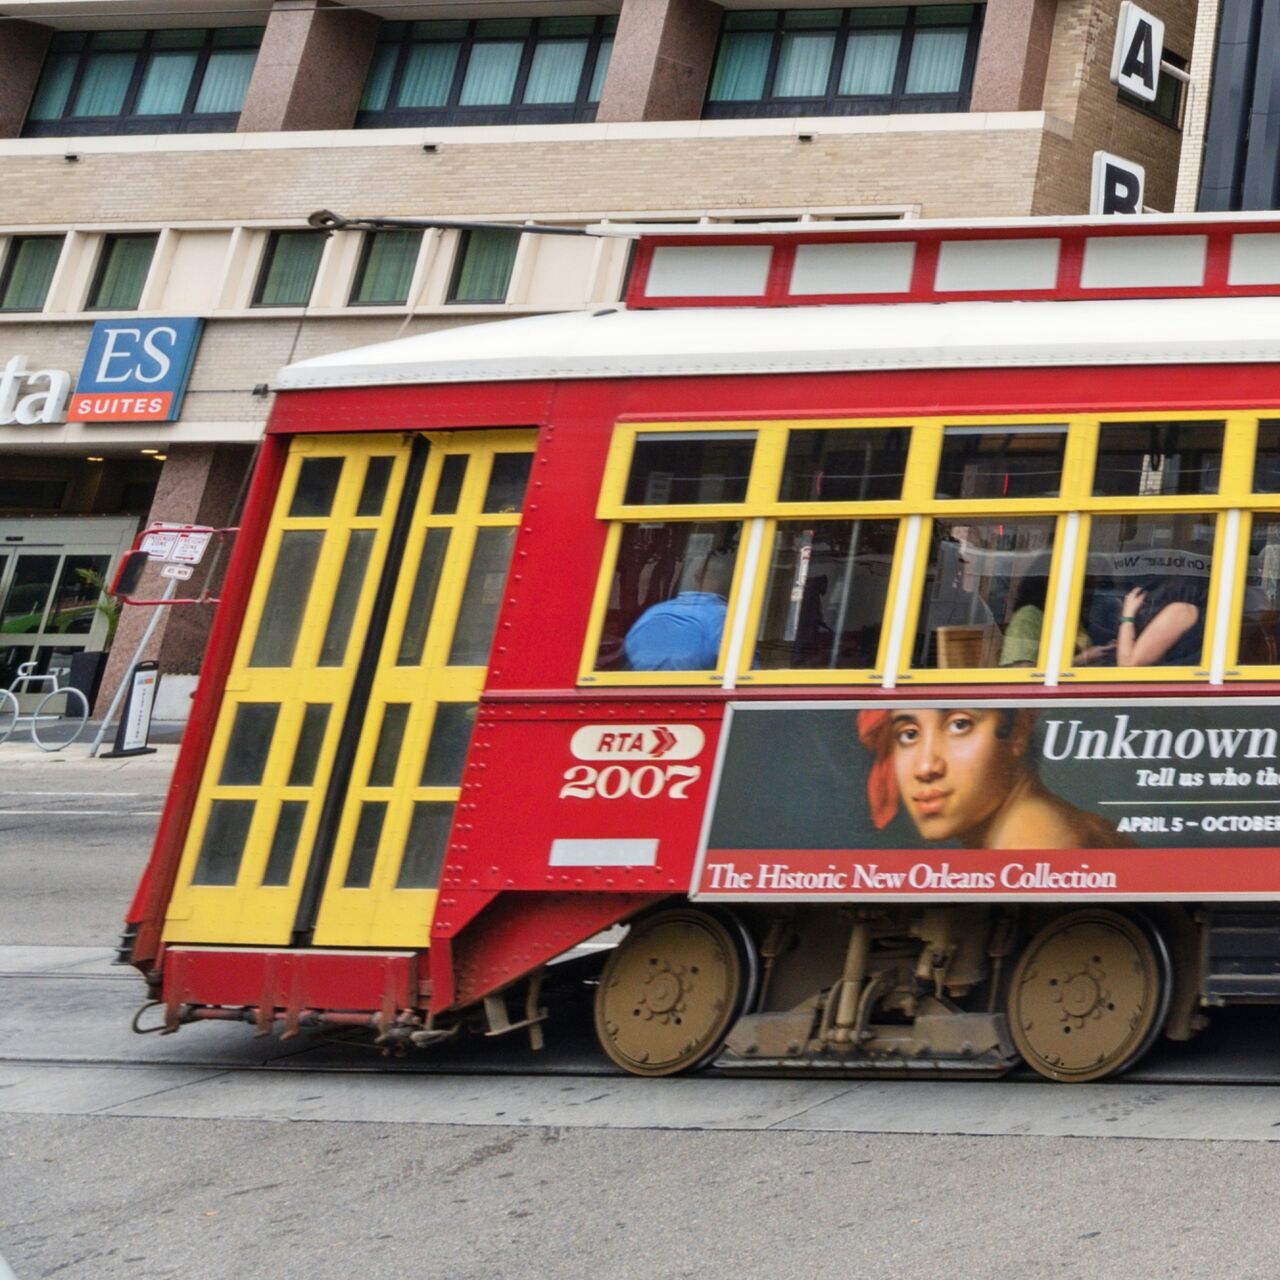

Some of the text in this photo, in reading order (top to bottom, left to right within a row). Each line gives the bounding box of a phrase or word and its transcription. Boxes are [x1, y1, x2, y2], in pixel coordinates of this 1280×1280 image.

[95, 326, 177, 383] ES
[77, 398, 163, 414] SUITES
[597, 733, 644, 752] RTA
[1042, 714, 1278, 760] Unknown
[559, 765, 701, 799] 2007
[1137, 767, 1176, 786] Tell
[1178, 772, 1204, 786] us
[1209, 767, 1251, 786] who
[1116, 817, 1169, 832] APRIL
[1171, 818, 1183, 832] 5
[706, 863, 1117, 889] The Historic New Orleans Collection
